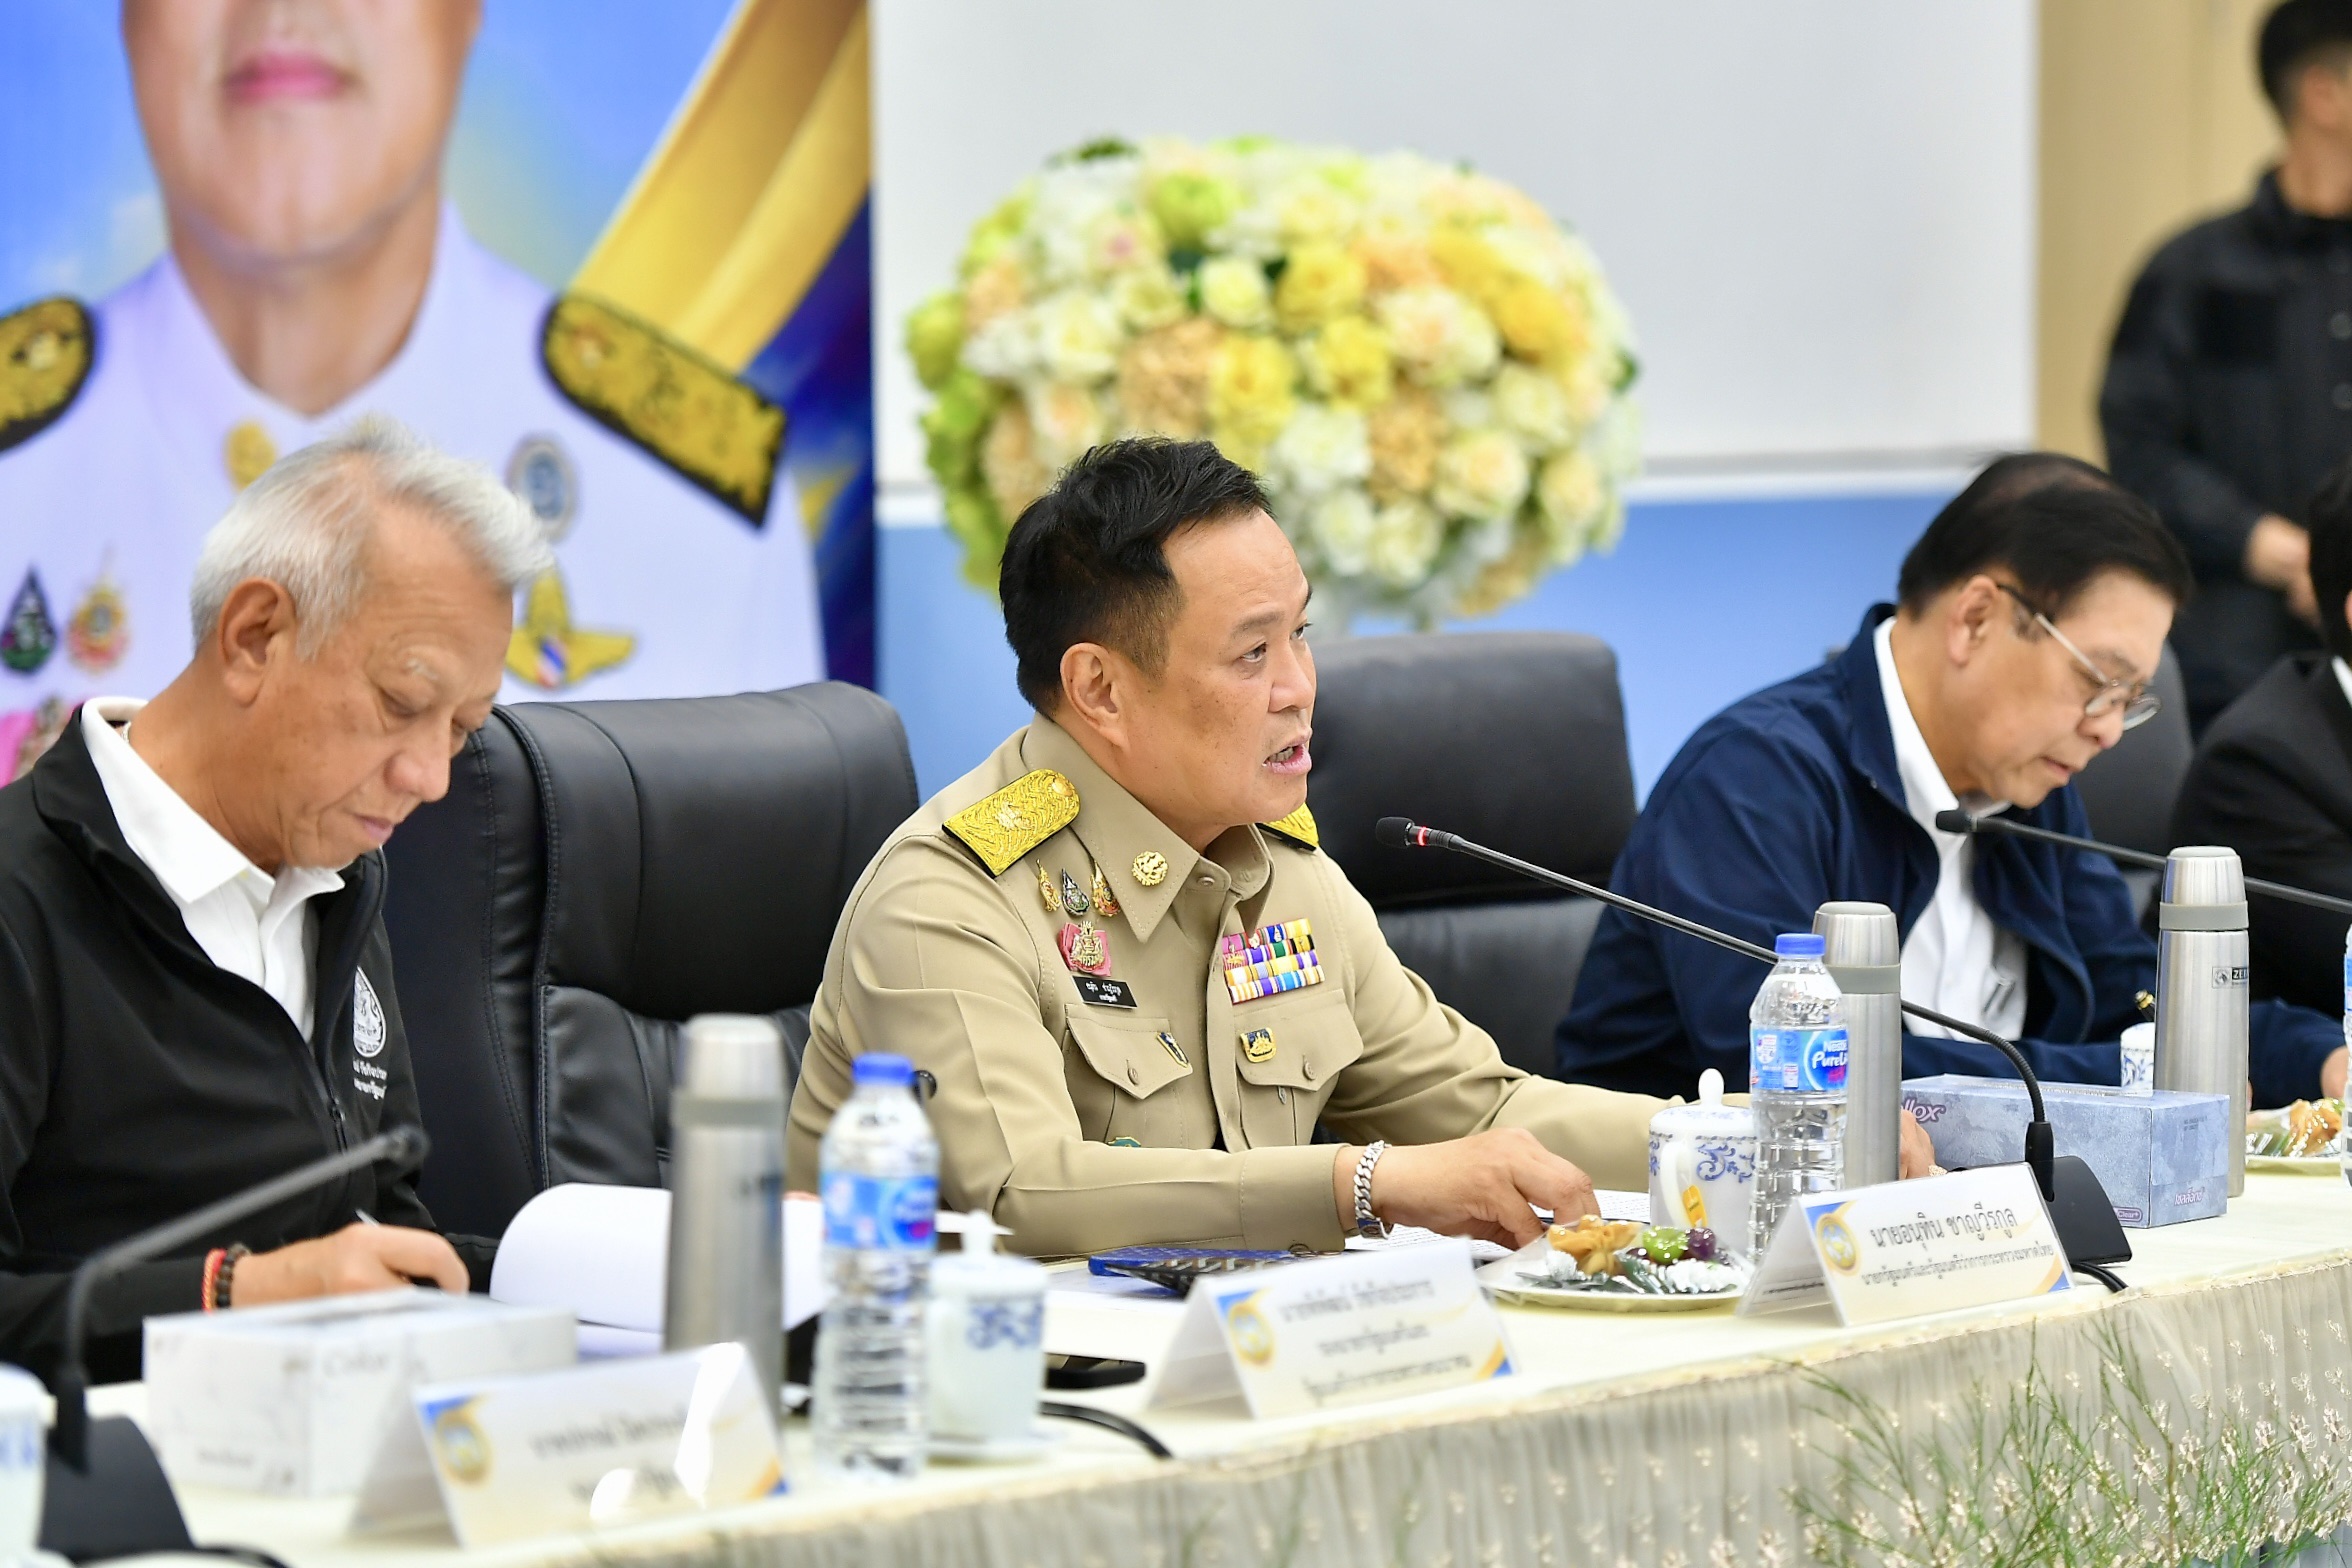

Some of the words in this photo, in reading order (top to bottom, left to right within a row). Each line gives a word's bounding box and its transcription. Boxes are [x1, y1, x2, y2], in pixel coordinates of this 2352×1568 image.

[2231, 967, 2248, 980] ZE
[1902, 1097, 1946, 1124] llox
[1870, 1211, 1945, 1251] นายอนุทิน
[1946, 1201, 2018, 1241] ชาญวีรกูล
